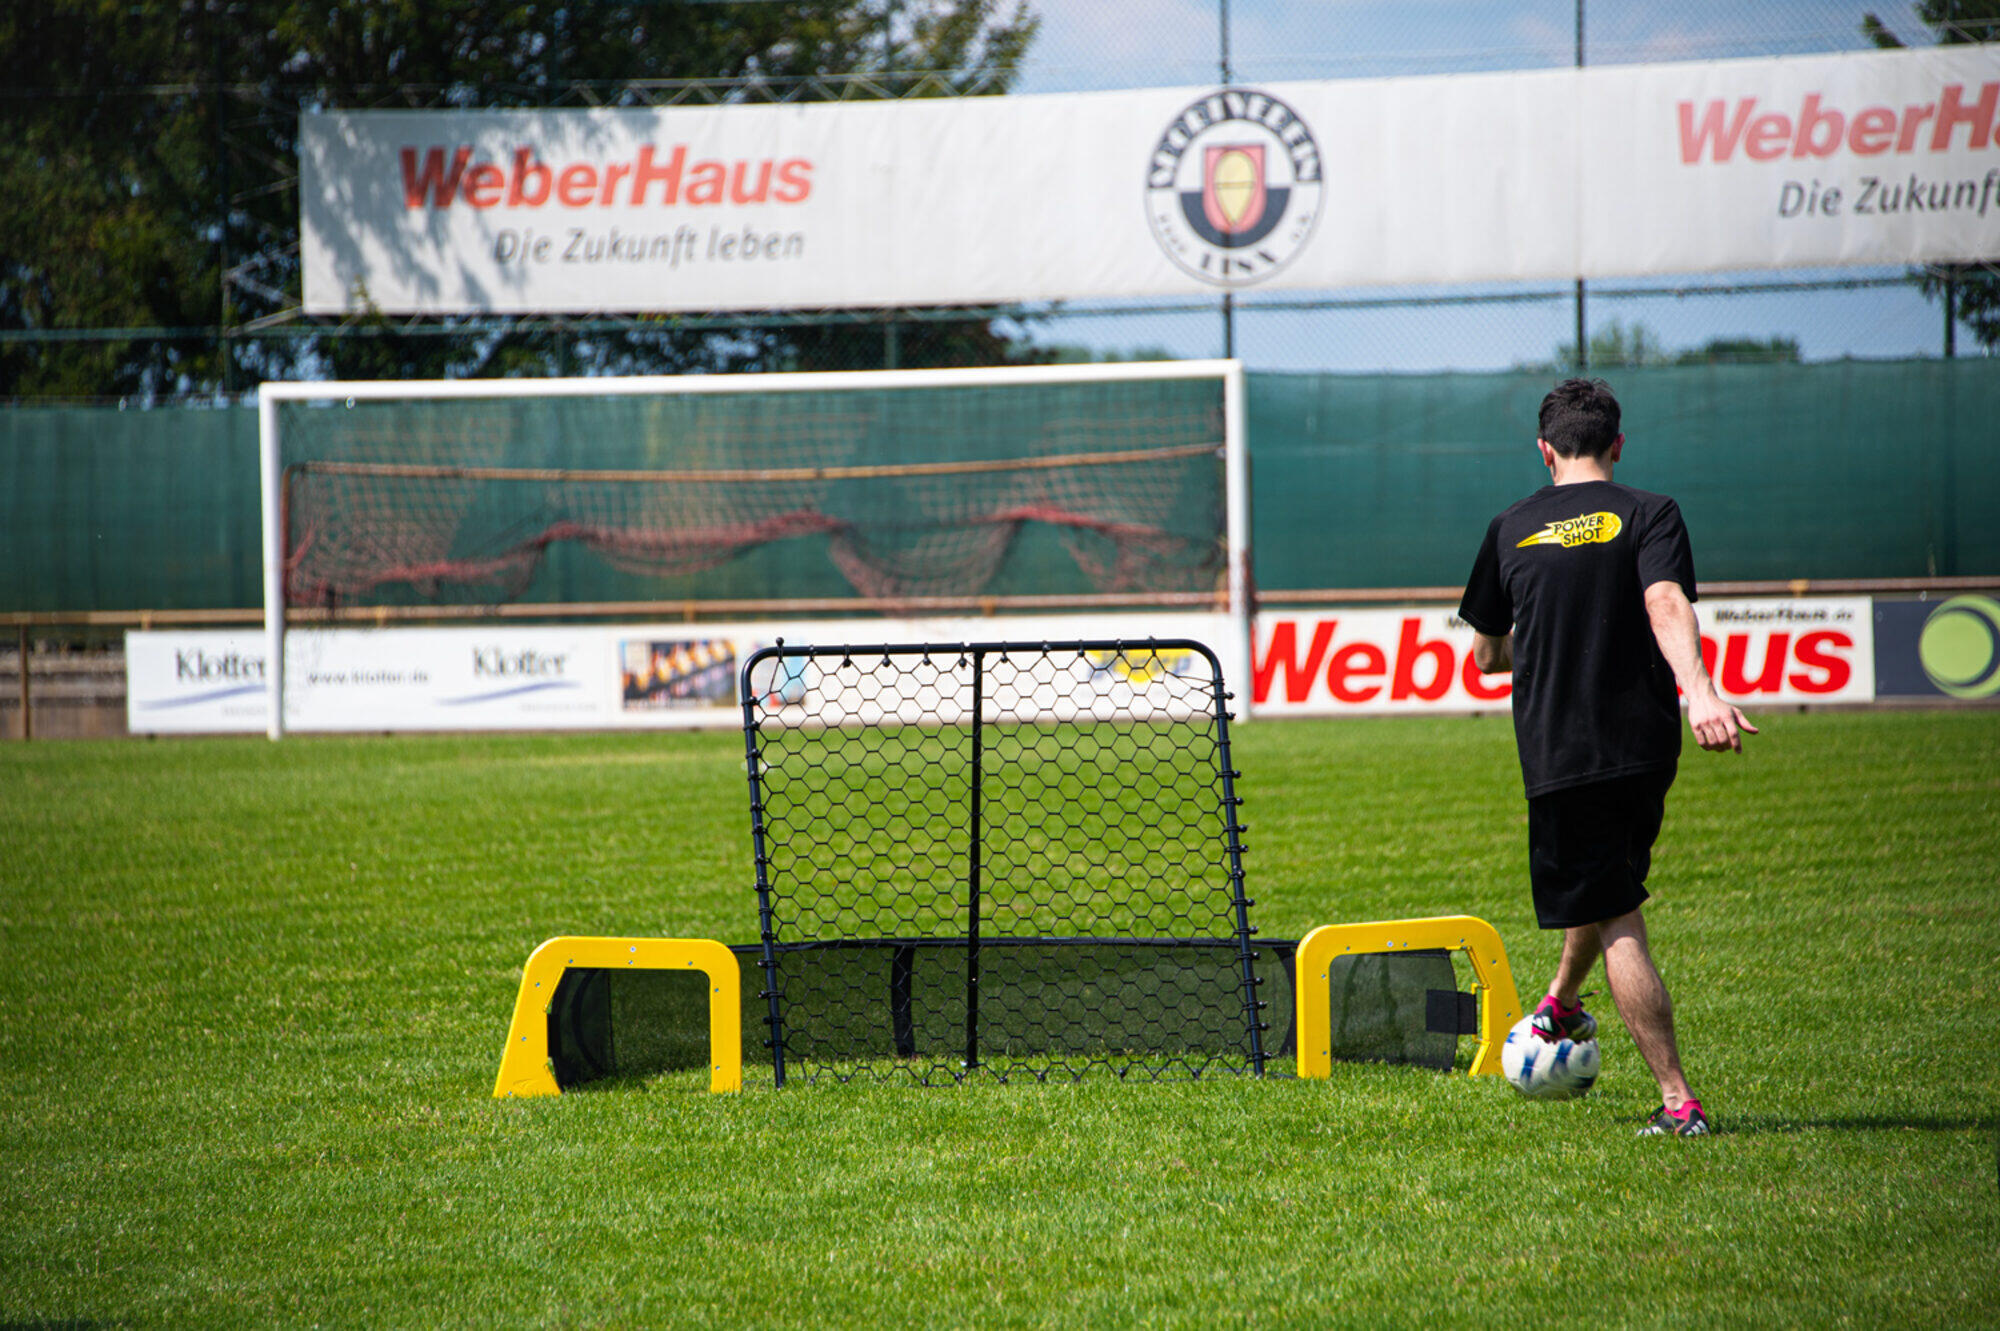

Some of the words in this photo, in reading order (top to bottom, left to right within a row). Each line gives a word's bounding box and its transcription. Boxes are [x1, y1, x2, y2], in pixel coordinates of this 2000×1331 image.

[1676, 81, 2000, 165] WeberH
[400, 146, 815, 208] WeberHaus
[1778, 178, 1843, 218] Die
[494, 227, 552, 264] Die
[561, 224, 698, 270] Zukunft
[706, 223, 805, 262] leben
[1553, 516, 1604, 535] POWER
[1563, 528, 1603, 546] SHOT
[473, 646, 568, 678] Klotter
